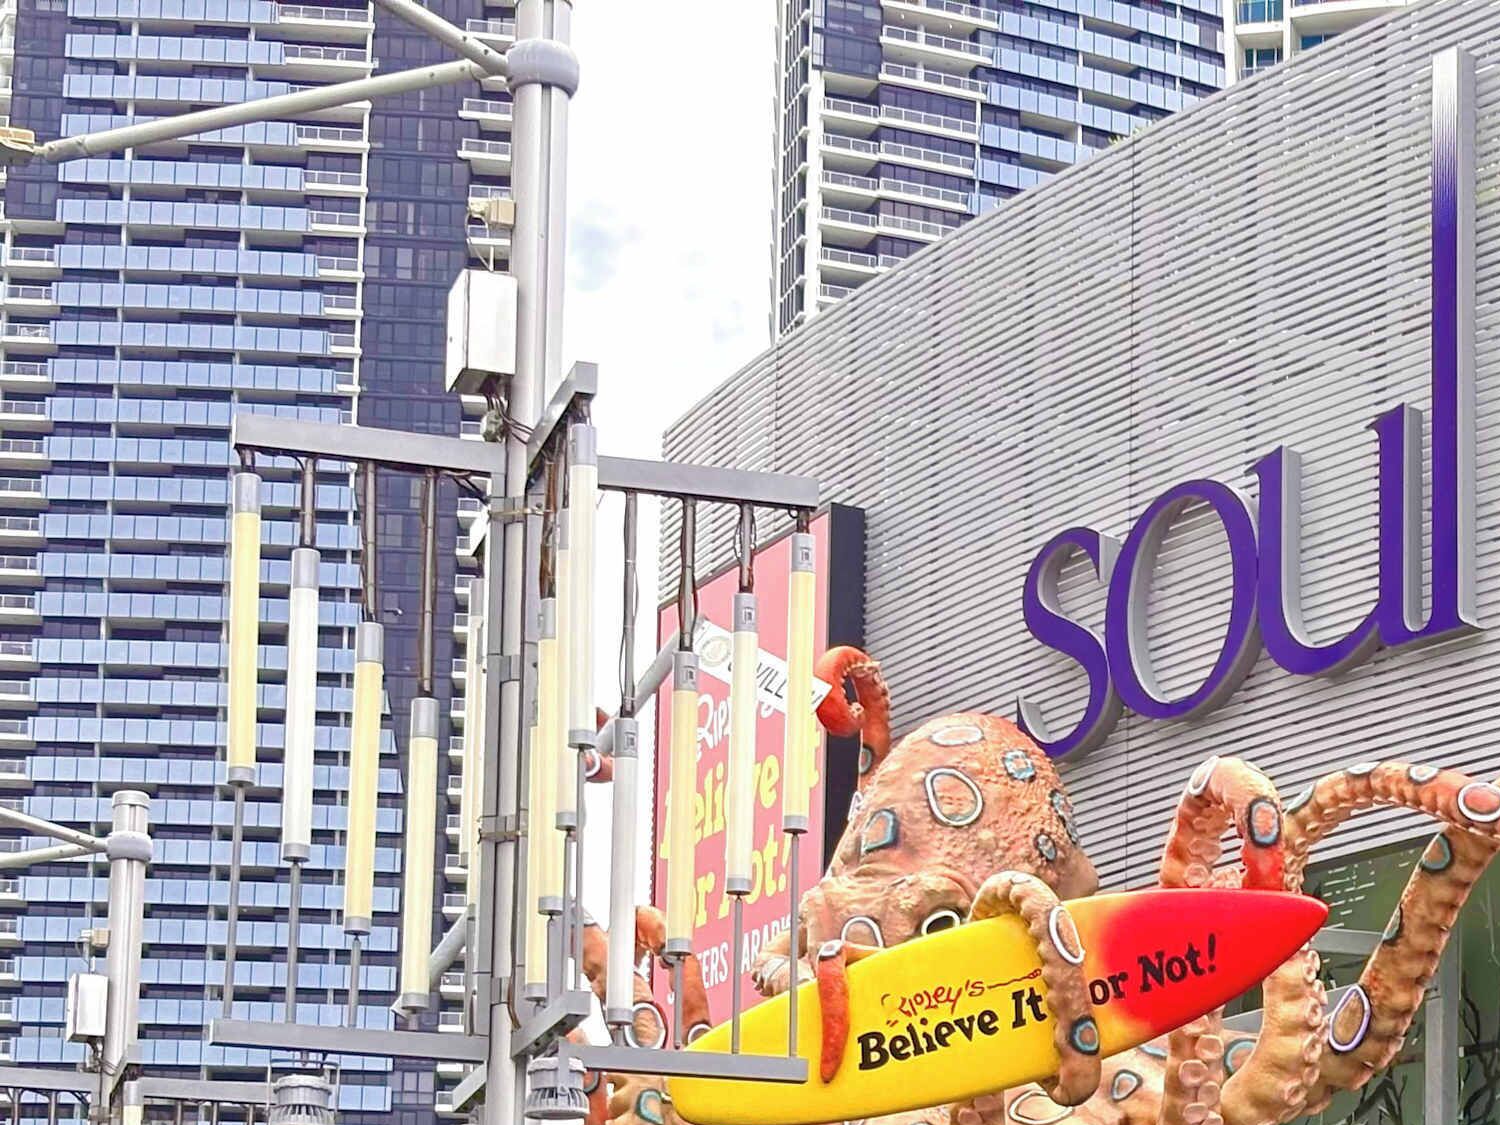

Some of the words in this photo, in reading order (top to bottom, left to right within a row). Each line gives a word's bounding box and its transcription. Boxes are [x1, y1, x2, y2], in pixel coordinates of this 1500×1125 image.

[1017, 48, 1482, 760] soul
[857, 1009, 999, 1071] Believe
[1012, 987, 1047, 1029] It
[1089, 969, 1129, 1006] or
[1138, 933, 1216, 993] Not!
